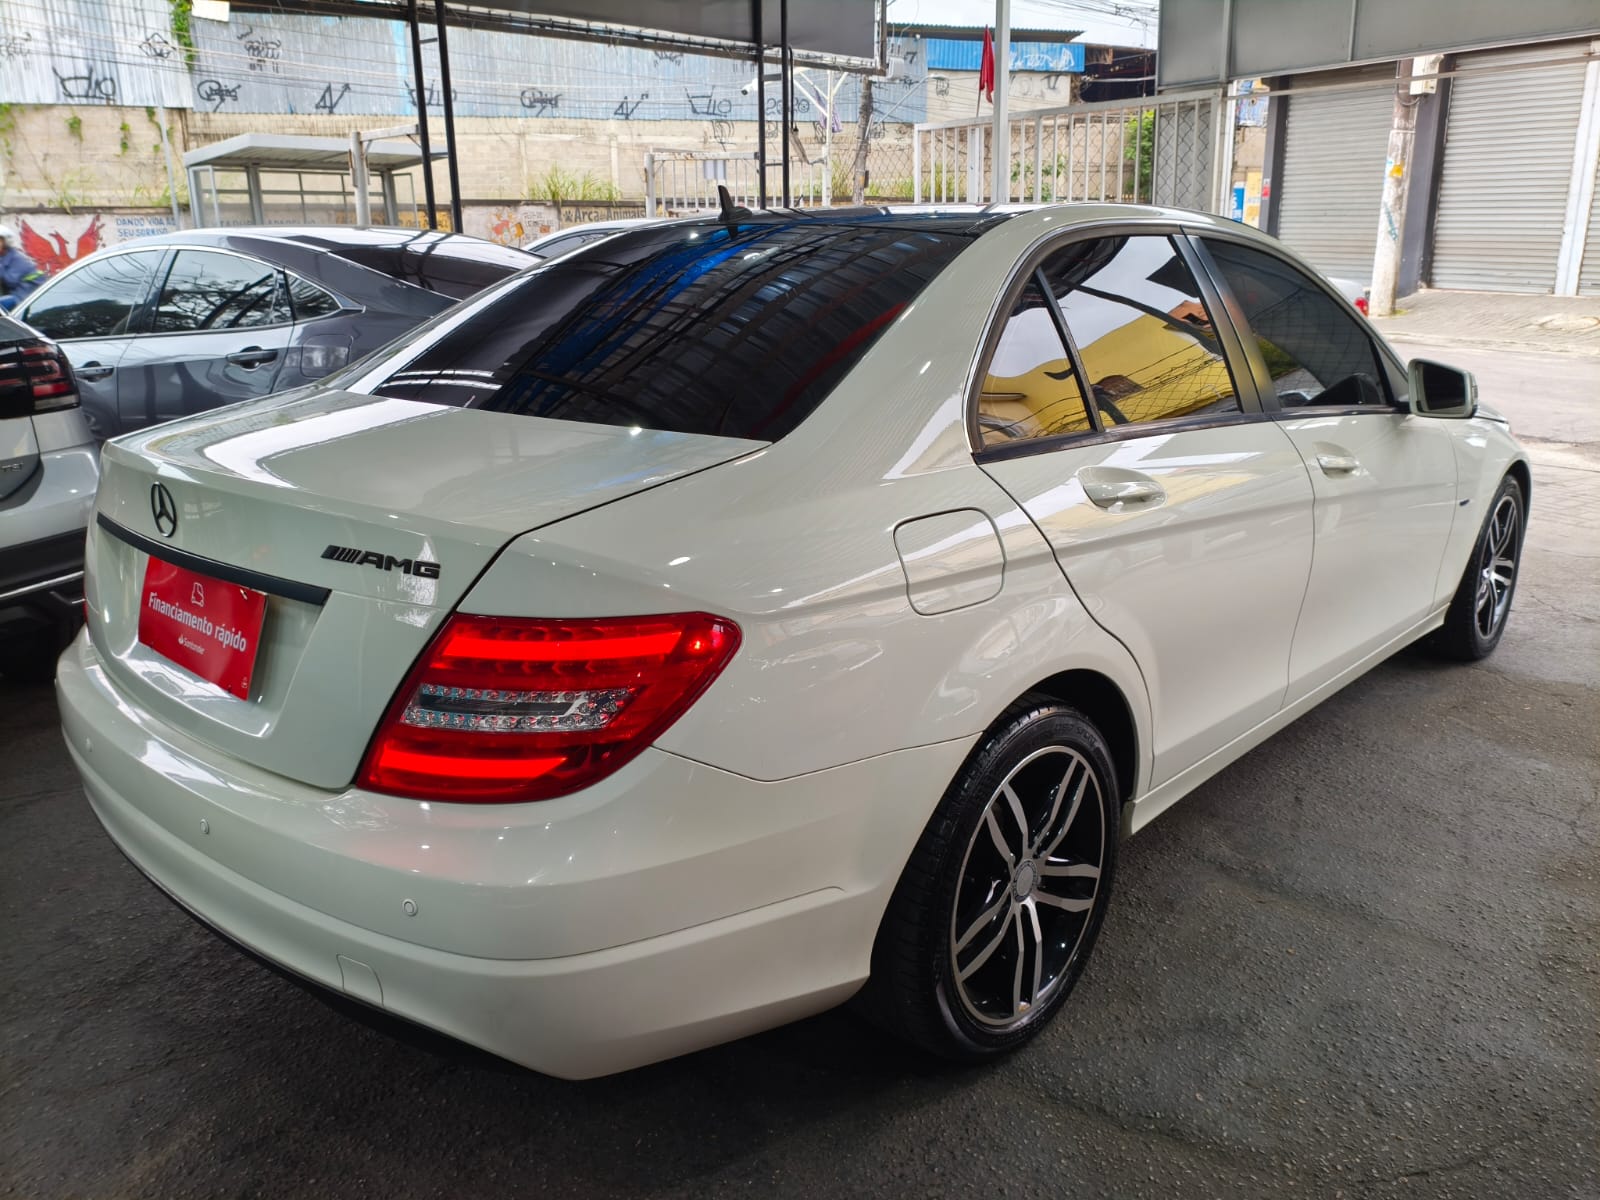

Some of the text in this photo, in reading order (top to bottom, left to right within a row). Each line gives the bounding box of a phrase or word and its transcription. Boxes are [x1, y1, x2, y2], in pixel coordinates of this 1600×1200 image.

[574, 207, 600, 222] Arca
[116, 217, 145, 226] DANDO
[118, 228, 134, 237] SEU
[148, 591, 247, 652] Financiamento rápido
